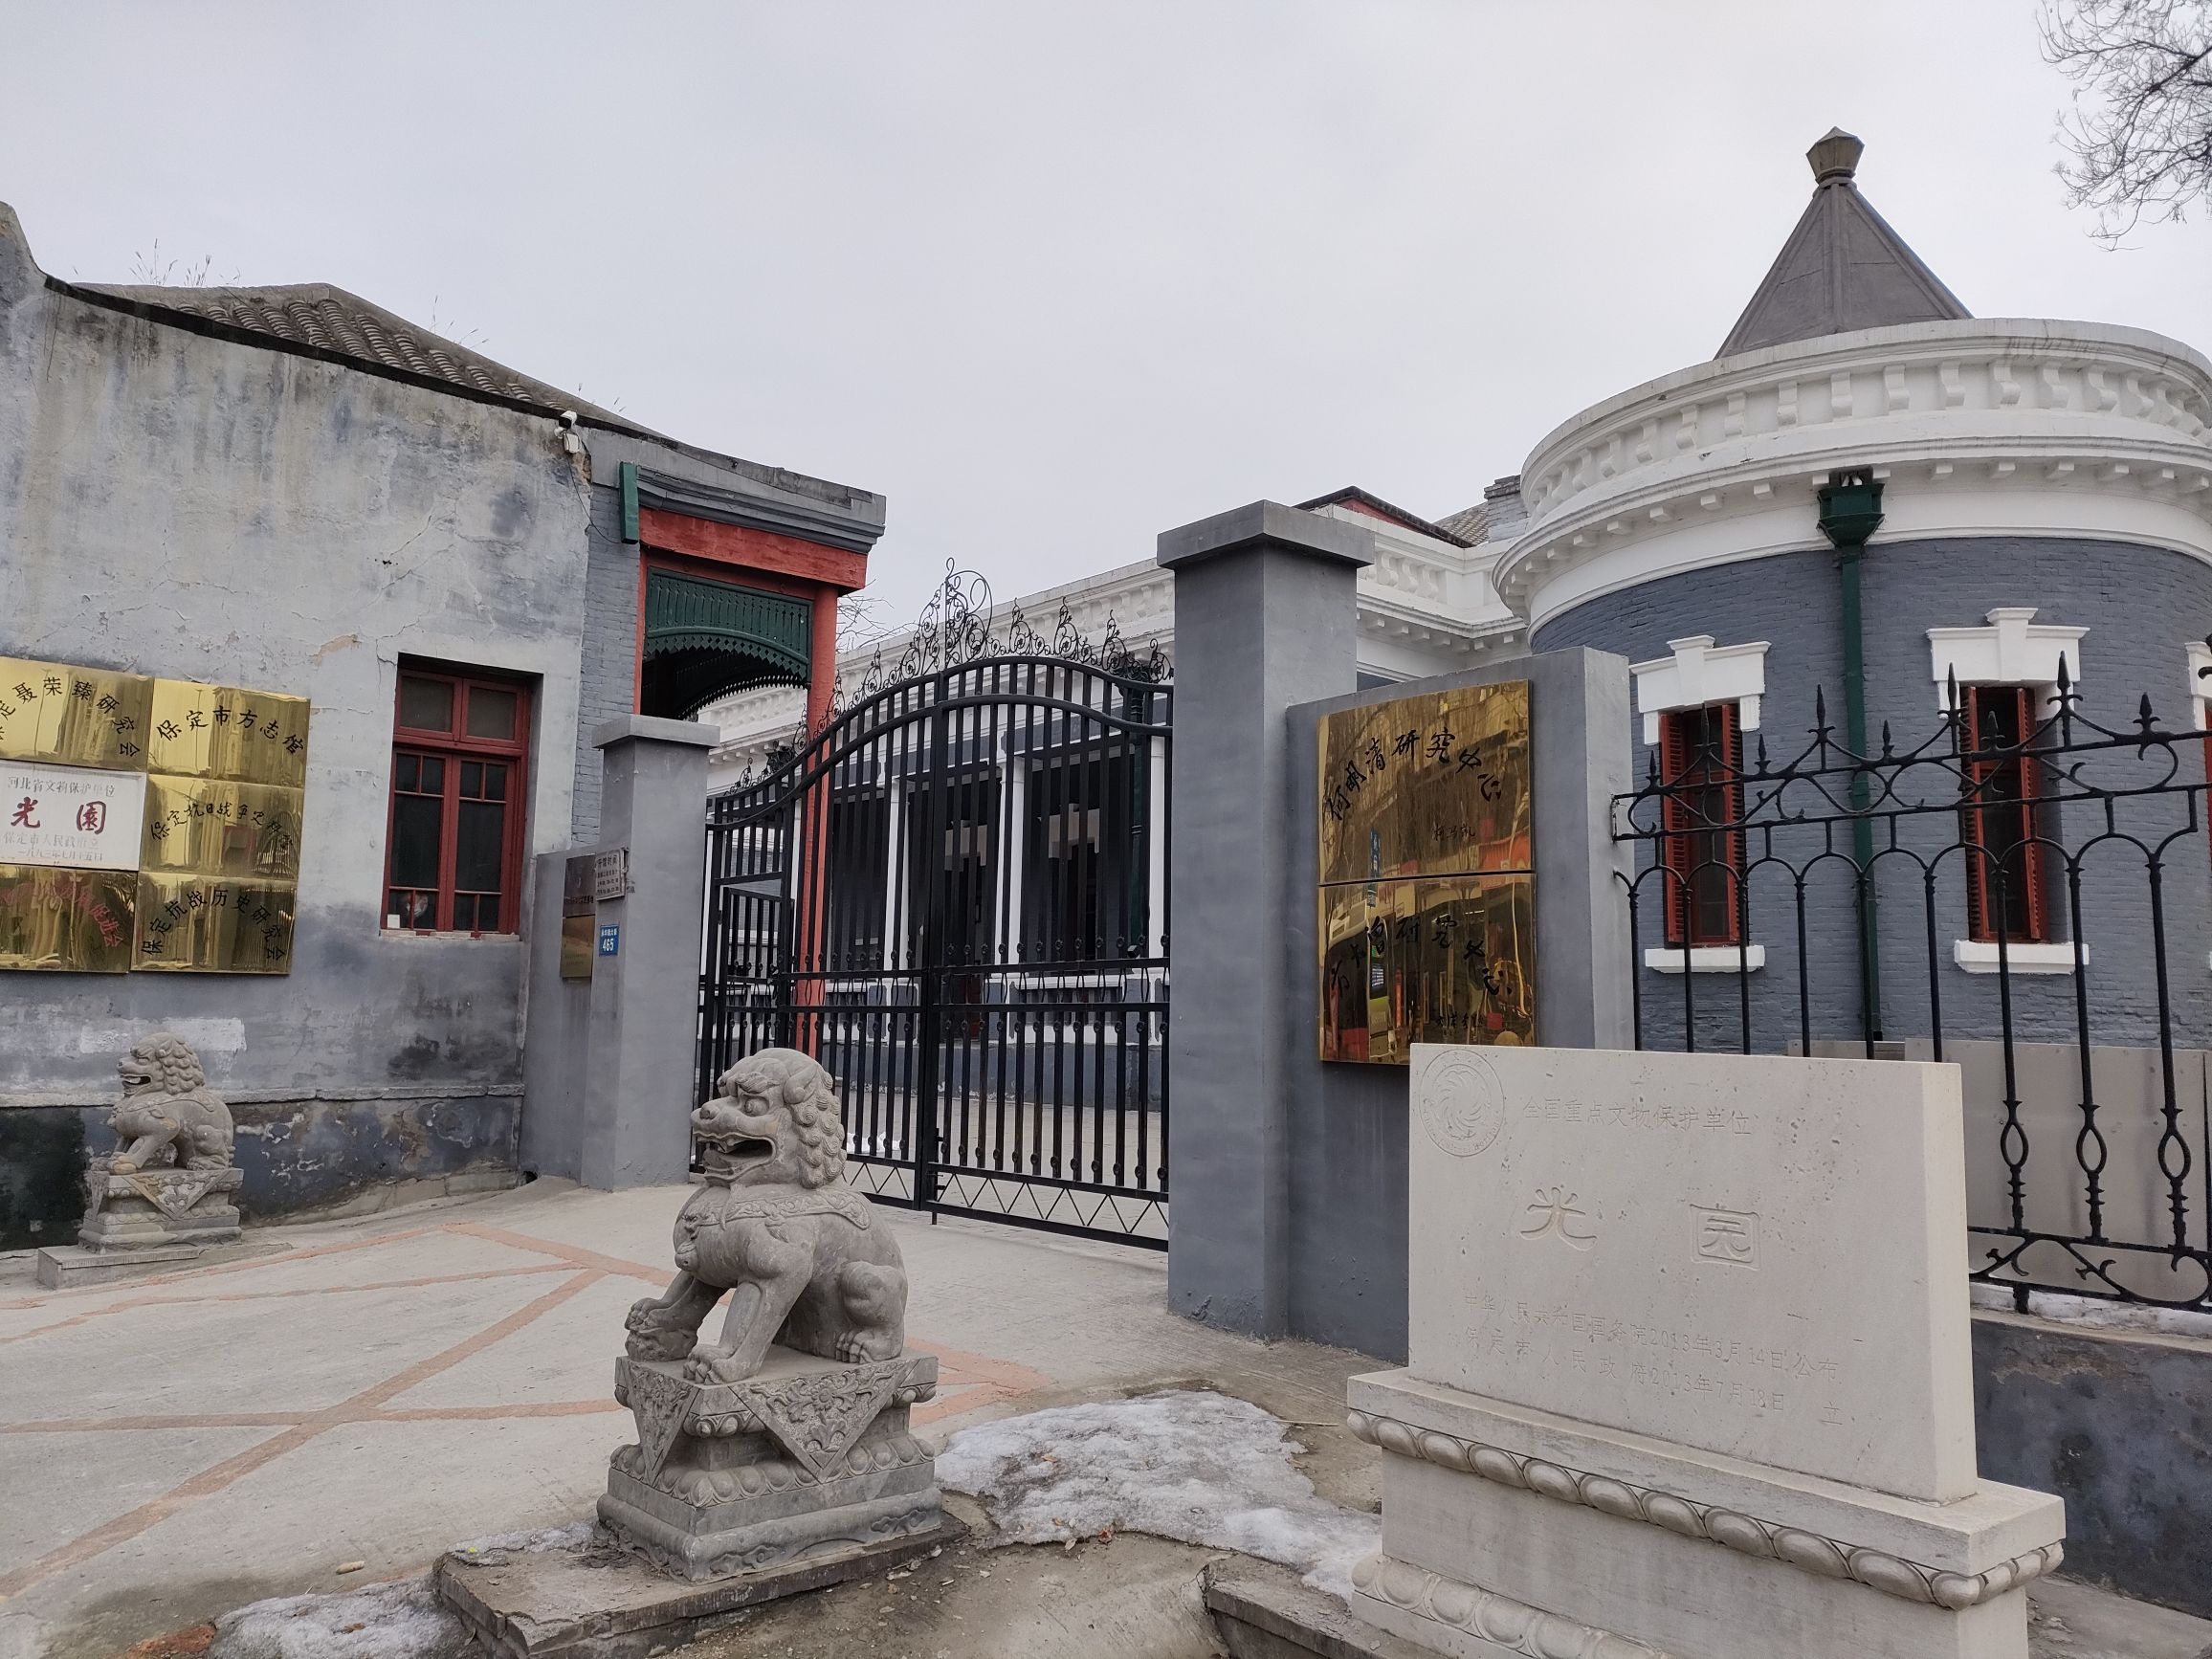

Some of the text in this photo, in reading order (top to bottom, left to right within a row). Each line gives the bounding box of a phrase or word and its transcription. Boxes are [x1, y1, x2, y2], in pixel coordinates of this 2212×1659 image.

[0, 677, 140, 757] 定聂荣臻研究会
[156, 705, 303, 754] 保定市方志馆
[1327, 727, 1501, 821] 何明清研究中心
[142, 889, 285, 961] 保定抗战历史研究会
[603, 938, 614, 952] 465
[1523, 1096, 1751, 1134] 全国重点文物保护单位
